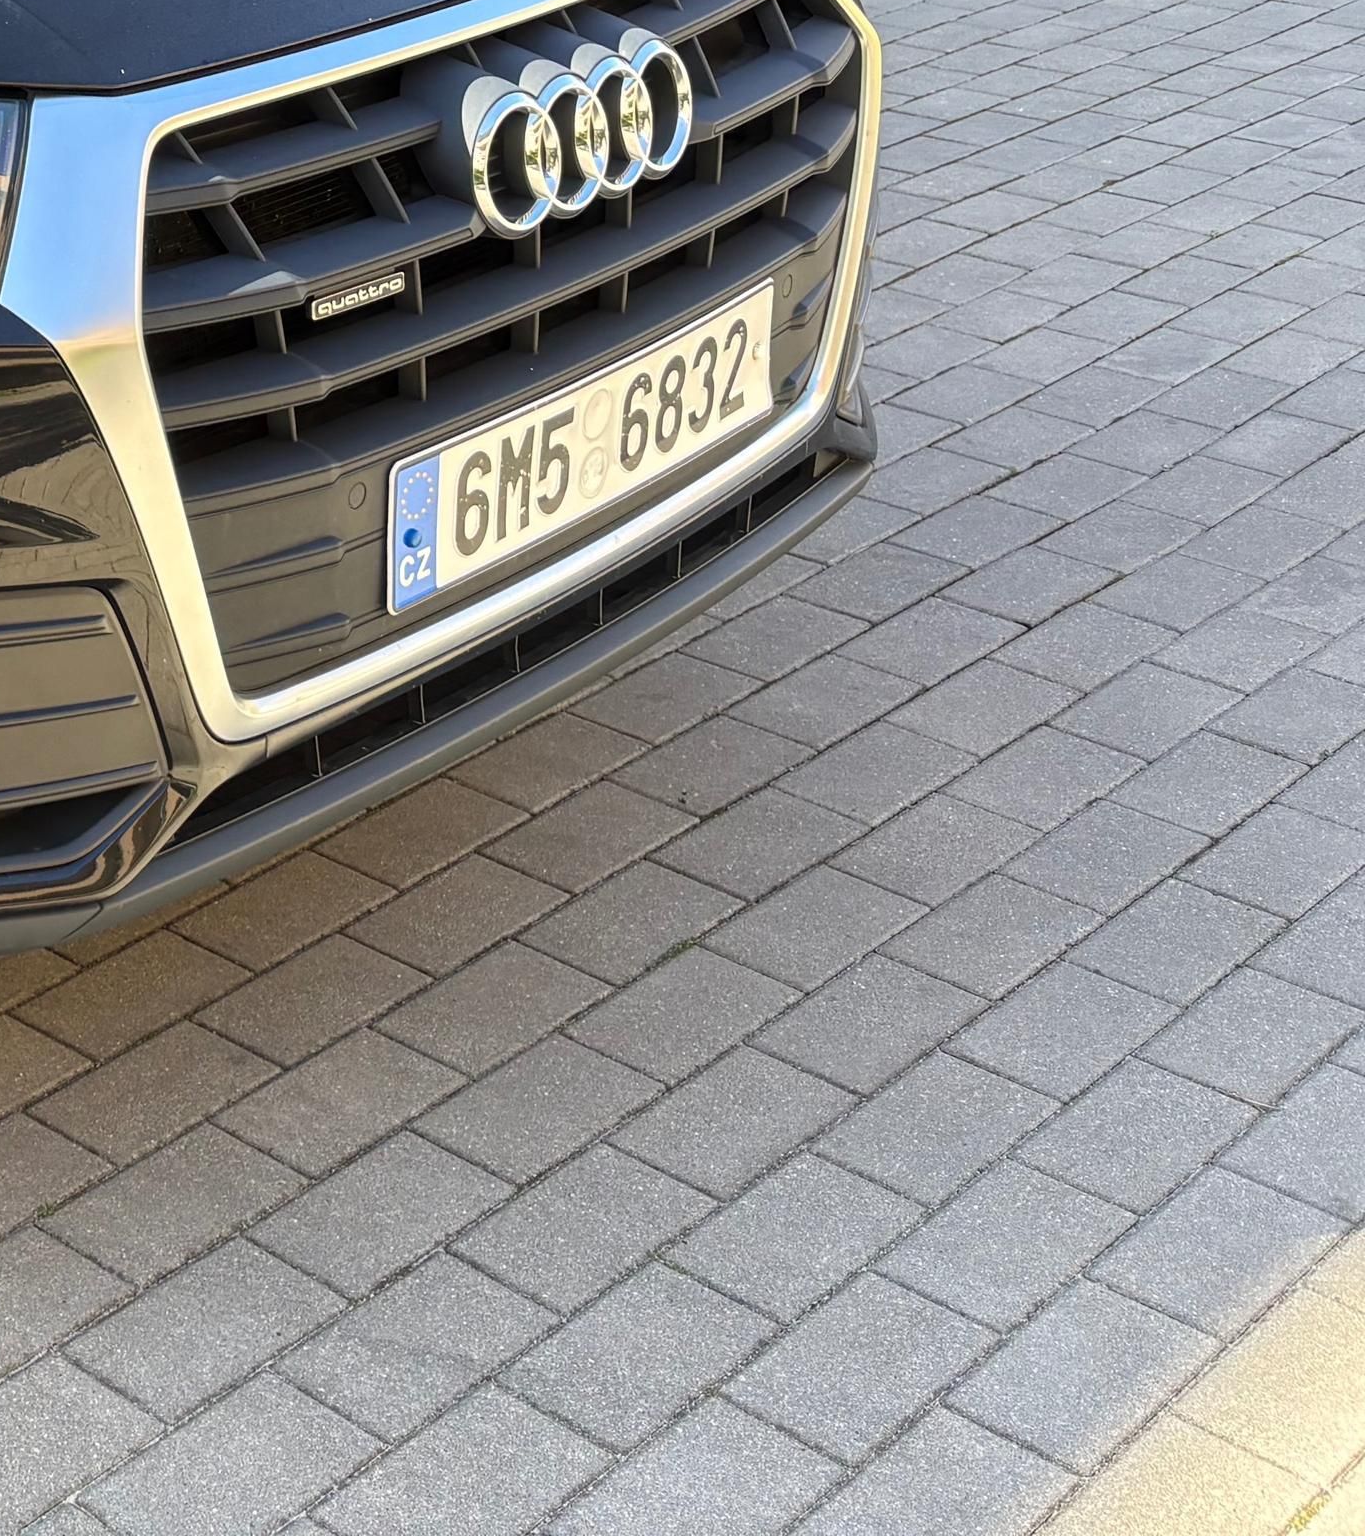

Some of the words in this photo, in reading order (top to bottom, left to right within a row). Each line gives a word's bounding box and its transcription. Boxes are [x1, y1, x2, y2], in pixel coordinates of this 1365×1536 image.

[317, 277, 402, 314] quattro
[453, 406, 576, 557] 6M5
[619, 317, 749, 473] 6832
[398, 545, 432, 588] CZ
